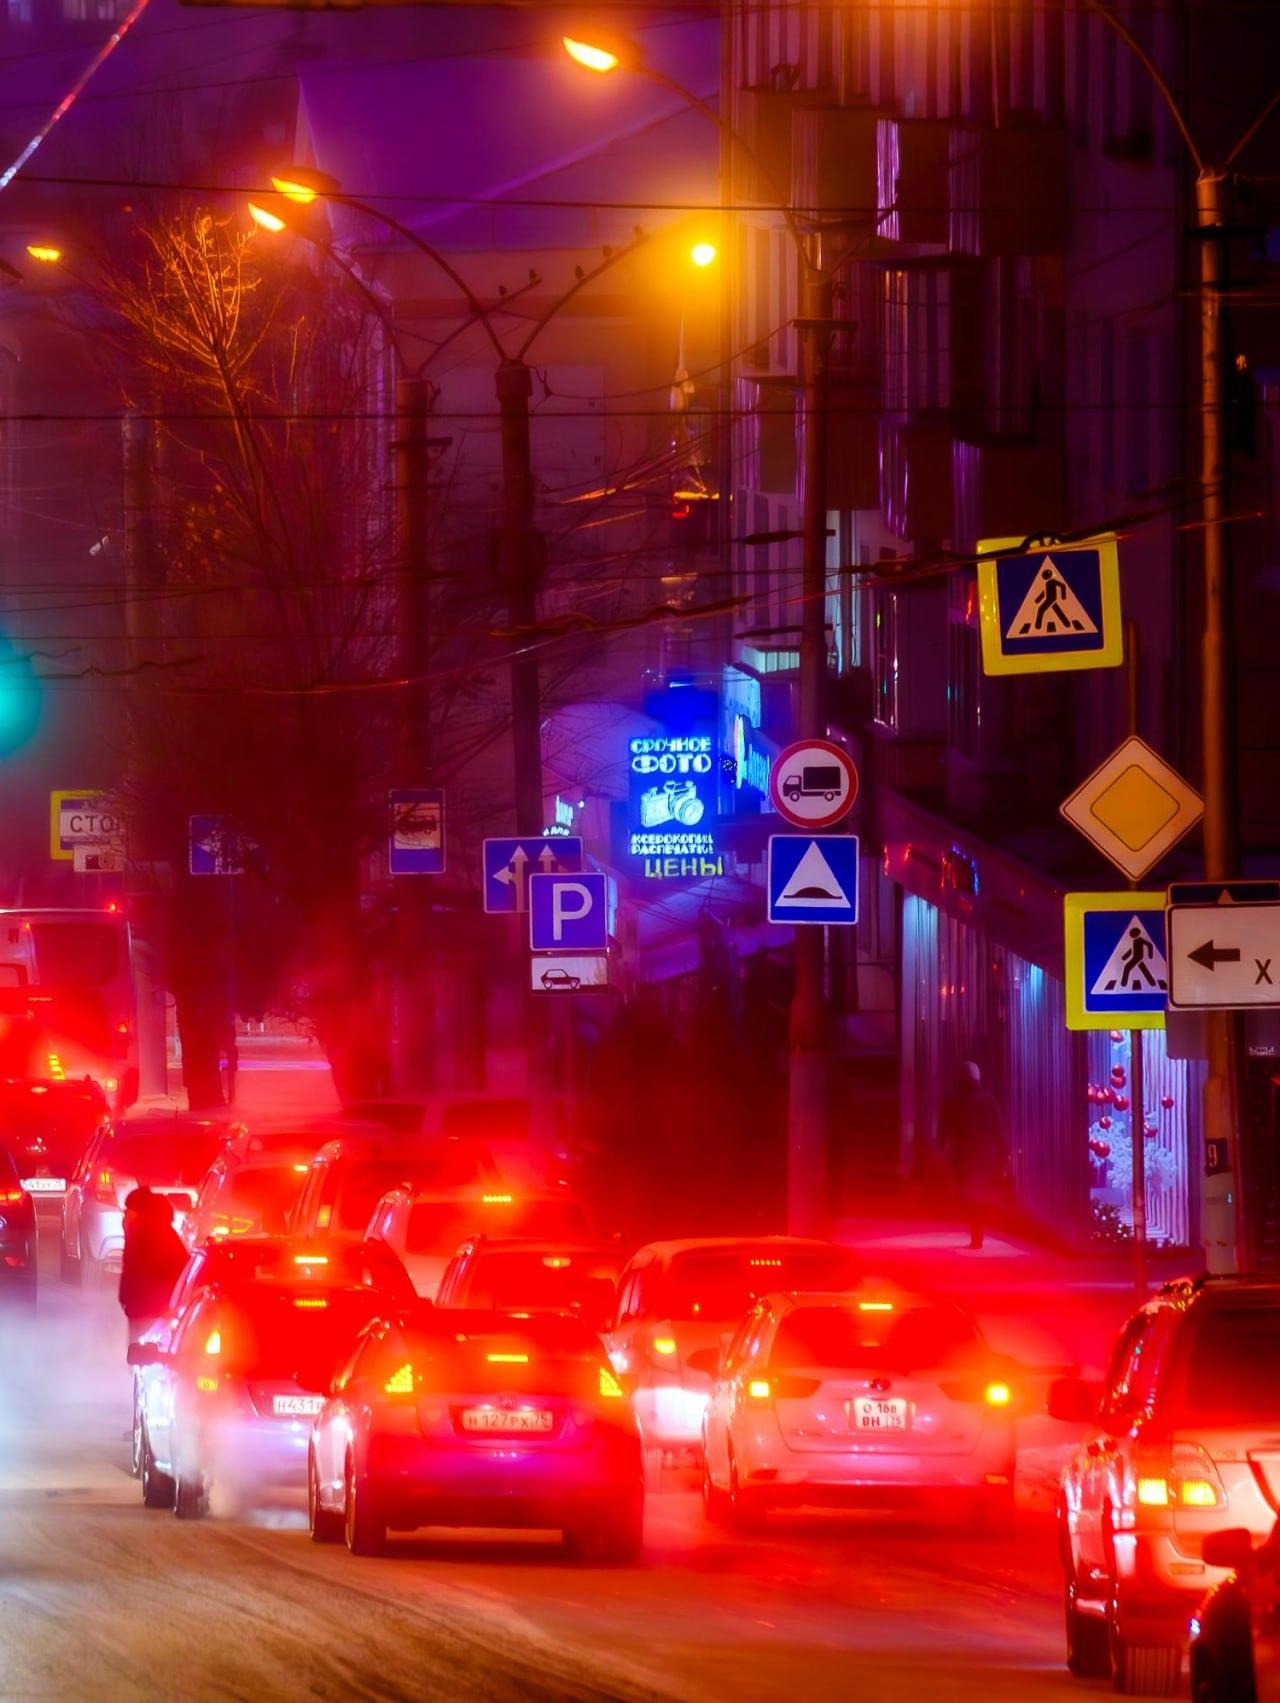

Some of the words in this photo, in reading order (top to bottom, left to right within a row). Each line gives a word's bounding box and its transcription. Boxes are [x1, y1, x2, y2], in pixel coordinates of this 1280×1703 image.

[630, 736, 712, 754] СРОЧНОЕ
[631, 753, 712, 774] ФОТО
[645, 857, 723, 879] ЦЕНЫ
[553, 883, 593, 940] P
